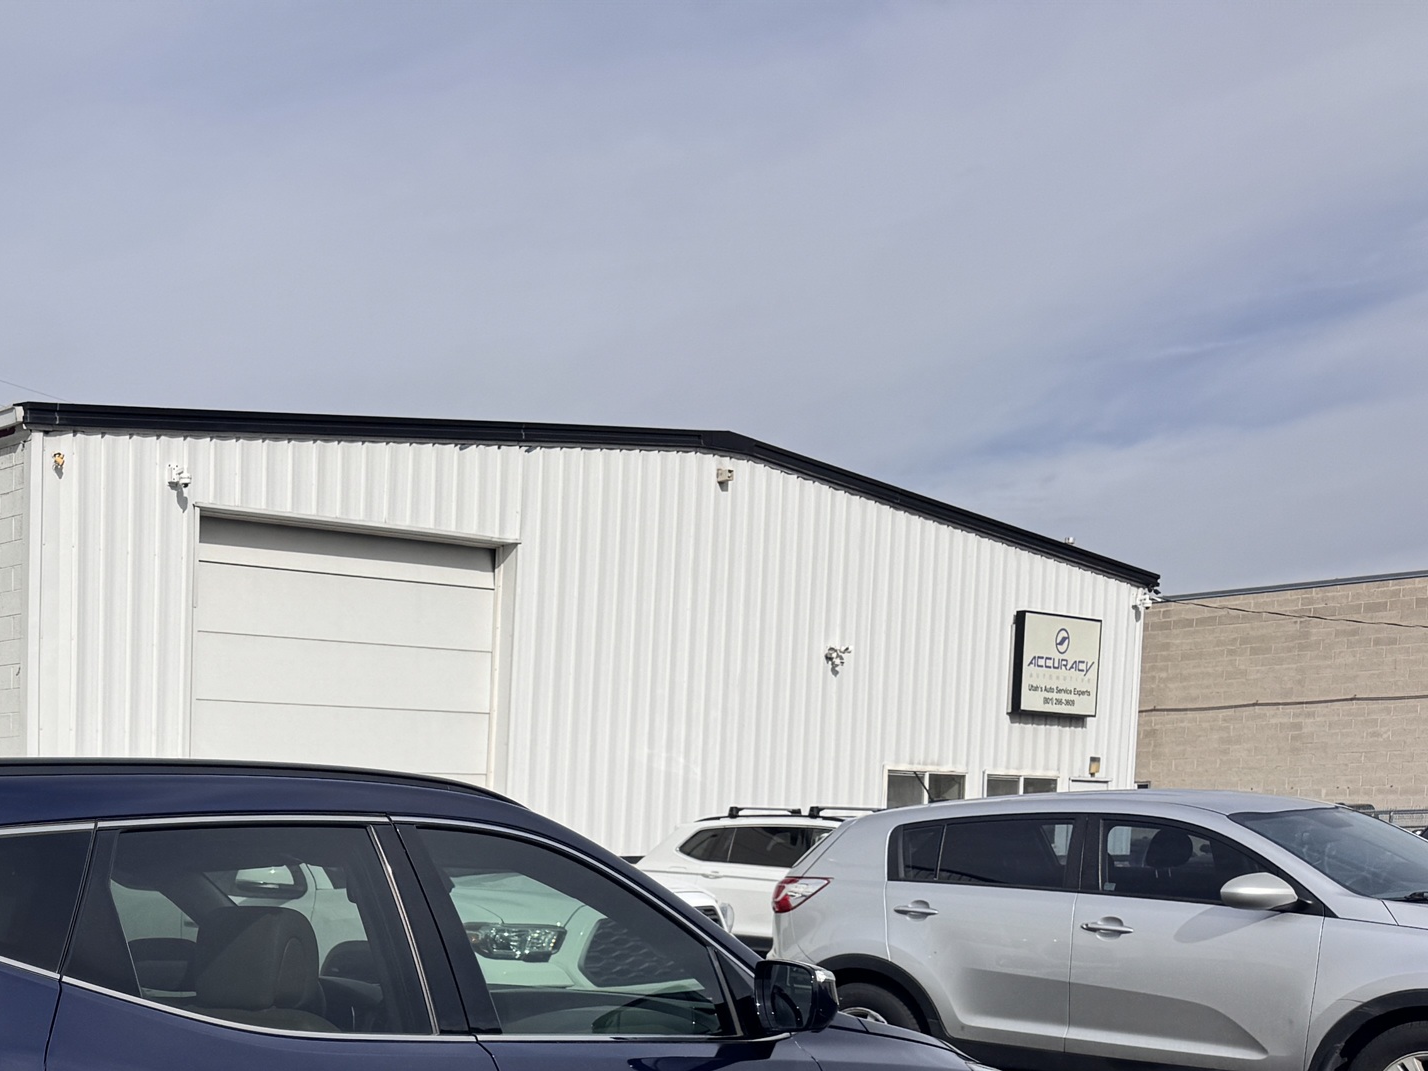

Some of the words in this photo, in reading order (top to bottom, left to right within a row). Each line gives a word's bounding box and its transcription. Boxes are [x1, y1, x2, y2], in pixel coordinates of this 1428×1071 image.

[1027, 655, 1095, 676] ACCURACY
[1028, 683, 1043, 692] Utah's
[1044, 685, 1054, 693] Auto
[1055, 686, 1072, 695] Service
[1073, 687, 1091, 697] Experts
